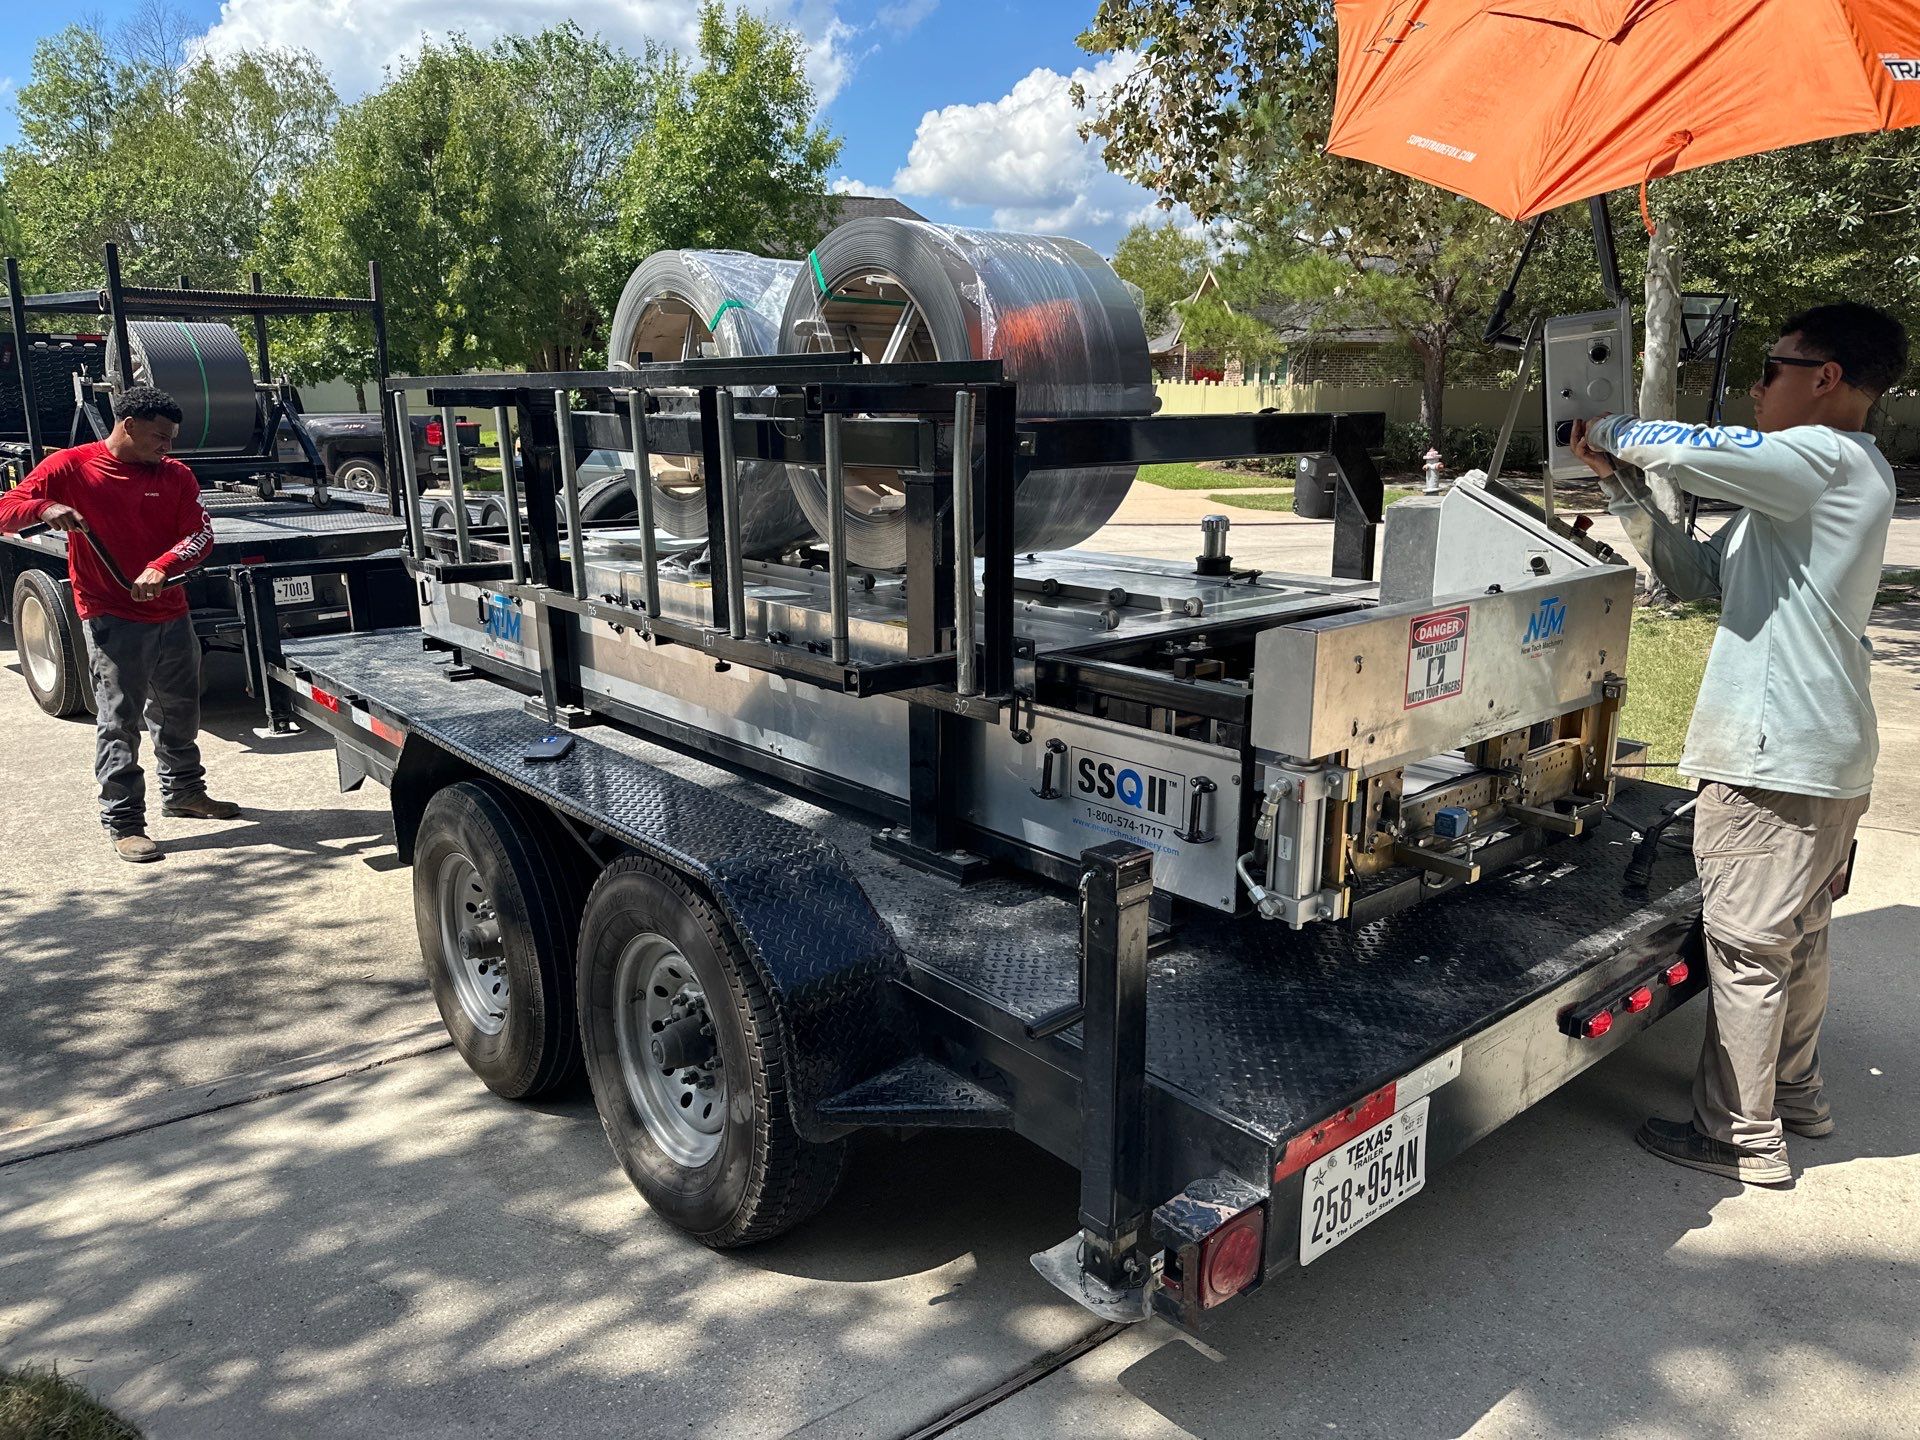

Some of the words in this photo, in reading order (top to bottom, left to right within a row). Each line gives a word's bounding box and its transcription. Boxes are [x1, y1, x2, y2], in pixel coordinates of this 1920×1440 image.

[281, 582, 310, 597] 7003
[1419, 620, 1460, 641] DANGER
[1521, 596, 1567, 645] NTM
[1416, 645, 1434, 661] HAND
[1434, 639, 1459, 656] HAZARD
[1531, 643, 1542, 652] Tech
[1542, 639, 1564, 649] Machinery
[952, 697, 970, 715] 30
[1407, 689, 1426, 704] WATCH
[1425, 685, 1440, 699] YOUR
[1439, 679, 1461, 696] FINGERS
[1077, 757, 1144, 809] SSQ
[1071, 816, 1180, 857] www.newtechmachinery.com
[1086, 807, 1164, 840] 1-800-574-1717
[1346, 1123, 1393, 1165] TEXAS
[1353, 1146, 1384, 1171] TRAILER
[1311, 1178, 1353, 1244] 258
[1367, 1136, 1419, 1206] 954N
[1336, 1227, 1348, 1239] The
[1349, 1215, 1364, 1230] Lone
[1365, 1207, 1378, 1221] Star
[1378, 1197, 1395, 1212] State
